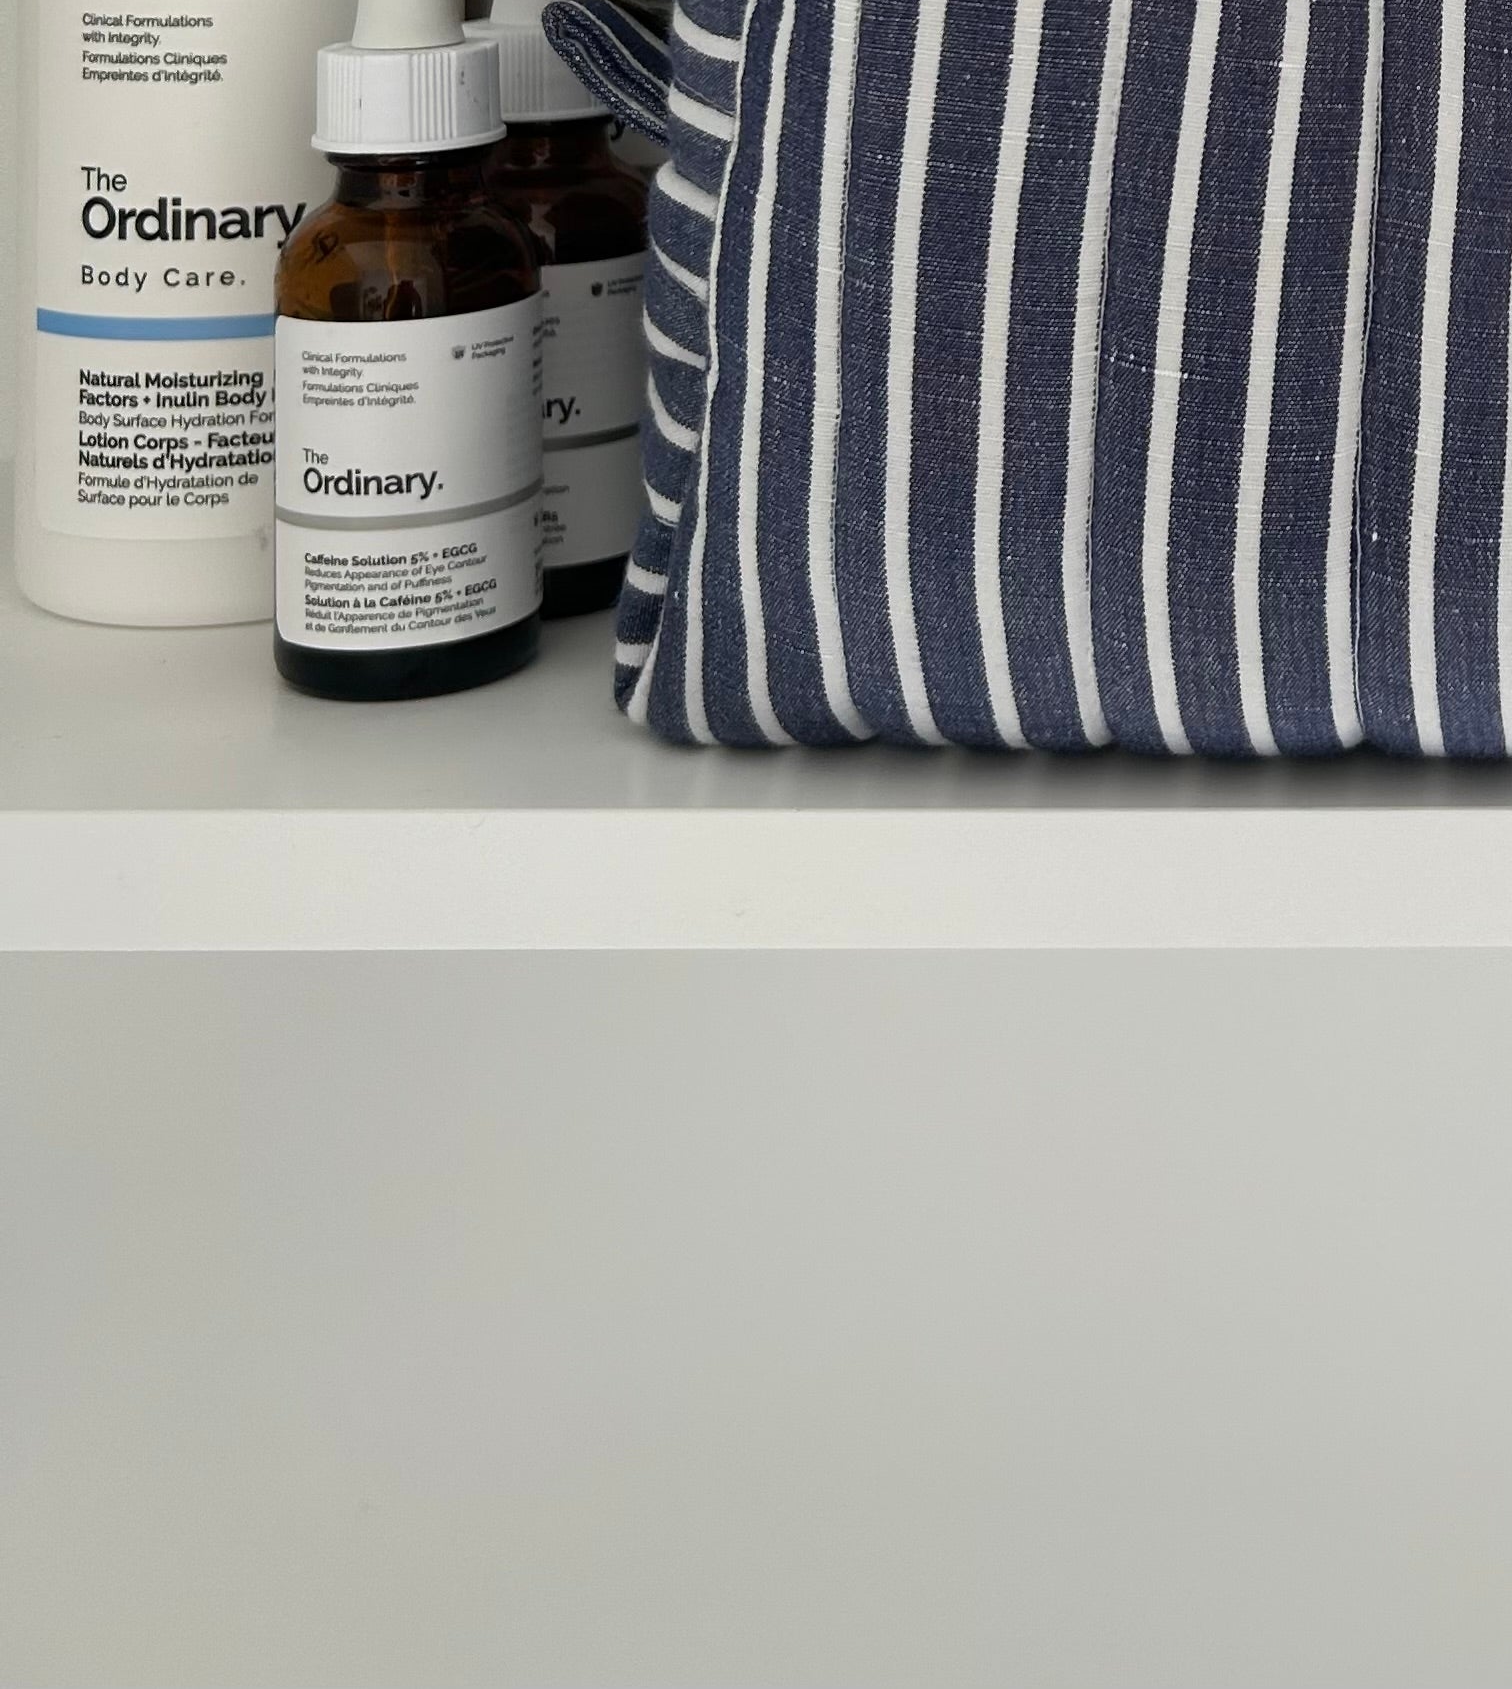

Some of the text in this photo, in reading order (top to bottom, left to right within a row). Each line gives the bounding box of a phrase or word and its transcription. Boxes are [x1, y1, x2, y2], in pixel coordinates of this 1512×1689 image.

[82, 12, 214, 28] Clinical Formulations
[82, 31, 106, 43] with
[82, 50, 228, 68] Formulations Cliniques
[82, 67, 150, 84] Empreintes
[81, 165, 127, 192] The
[82, 196, 308, 250] Ordinary
[81, 263, 247, 294] Body Care.
[302, 351, 408, 364] Clinical Formulations
[79, 368, 264, 391] Natural Moisturizing
[302, 366, 320, 376] with
[302, 380, 420, 395] Formulations Cliniques
[79, 388, 139, 409] Factors
[156, 391, 210, 409] Inulin
[215, 389, 268, 409] Body
[302, 394, 355, 408] Empreintes
[78, 410, 111, 429] Body
[113, 412, 168, 429] Surface
[171, 412, 246, 431] Hydration
[79, 430, 130, 449] Lotion
[133, 434, 190, 455] Corps
[78, 449, 149, 470] Naturels
[302, 447, 329, 465] The
[78, 471, 259, 493] Formule d'Hydratation de
[303, 467, 444, 500] Ordinary.
[77, 488, 230, 510] Surface pour le Corps
[304, 552, 349, 567] Caffeine
[352, 554, 407, 567] Solution
[410, 551, 430, 565] 5%
[442, 542, 478, 560] EGCG
[304, 555, 487, 581] Reduces Appearance of Eye Contour
[304, 593, 350, 609] Solution
[364, 596, 377, 608] la
[379, 593, 432, 608] Caféine
[465, 578, 498, 597] EGCG
[368, 581, 388, 592] and
[390, 579, 402, 591] of
[398, 609, 413, 620] de
[415, 597, 484, 618] Pigmentation
